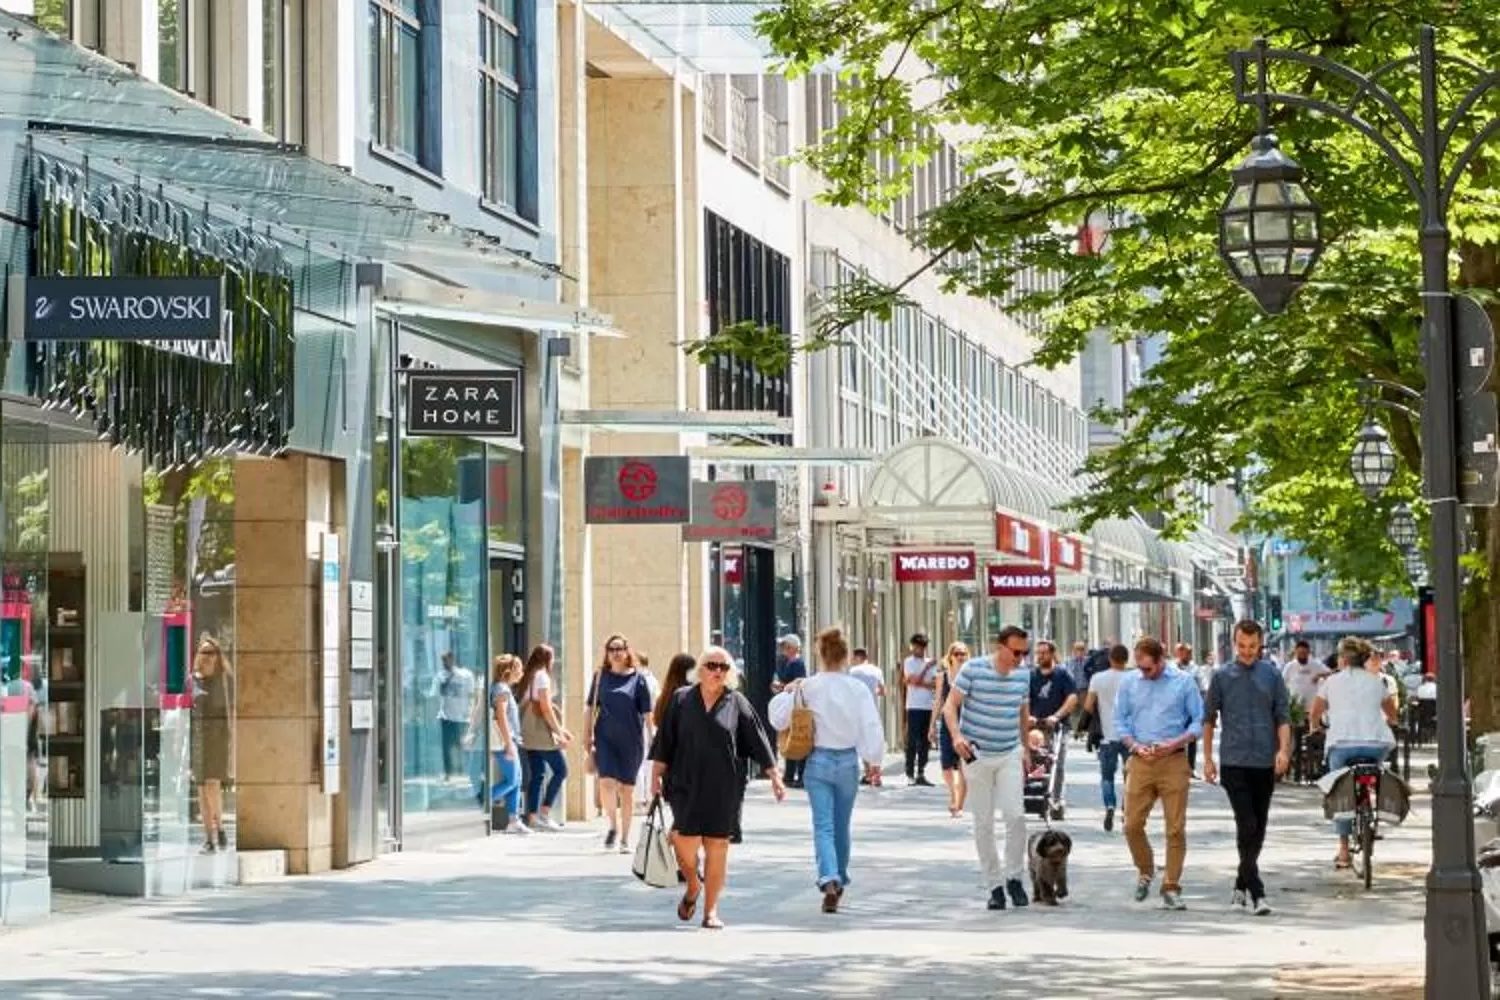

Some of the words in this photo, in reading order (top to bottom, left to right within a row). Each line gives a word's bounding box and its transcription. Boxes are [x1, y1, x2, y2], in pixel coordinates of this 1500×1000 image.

[69, 296, 211, 319] SWAROVSKI
[424, 387, 499, 401] ZARA
[423, 409, 499, 424] HOME
[899, 555, 970, 571] MAREDO
[991, 574, 1051, 588] MAREDO
